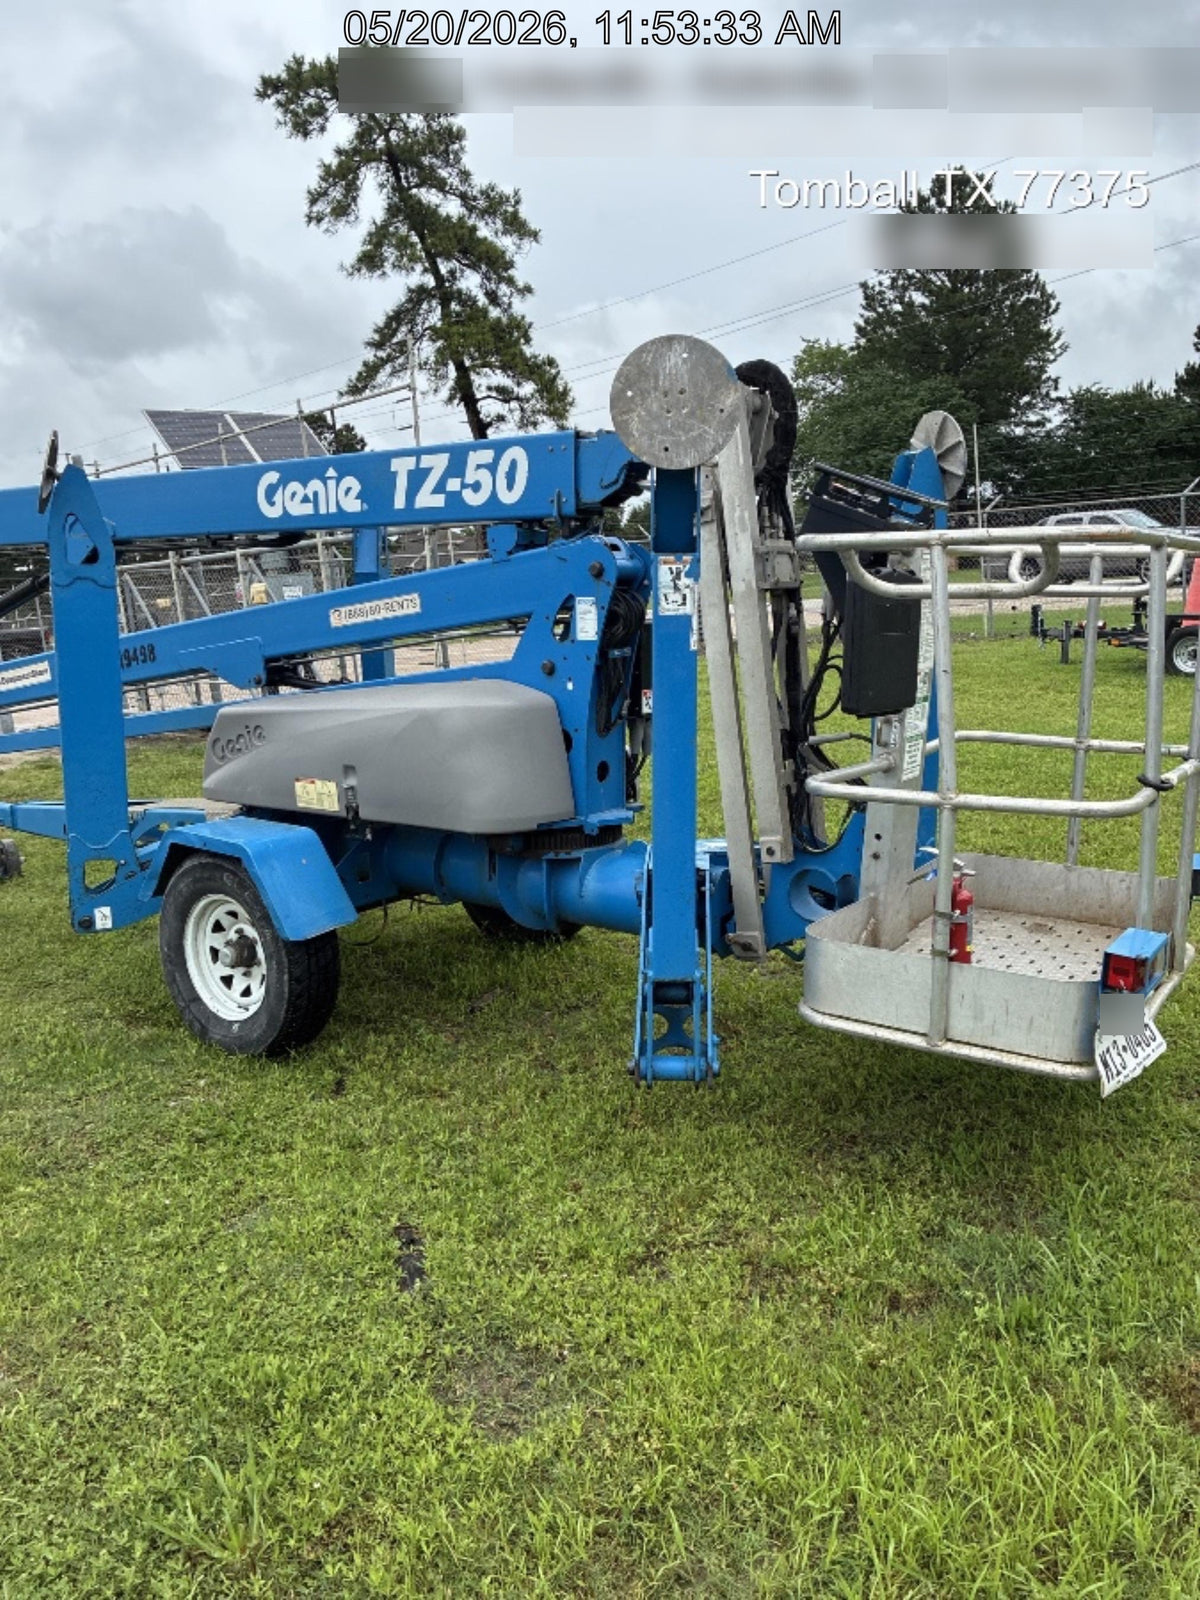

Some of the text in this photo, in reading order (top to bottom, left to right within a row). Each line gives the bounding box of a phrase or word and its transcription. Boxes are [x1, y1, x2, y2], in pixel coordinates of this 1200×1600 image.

[256, 445, 529, 519] Genie TZ-50
[211, 724, 266, 765] Genie
